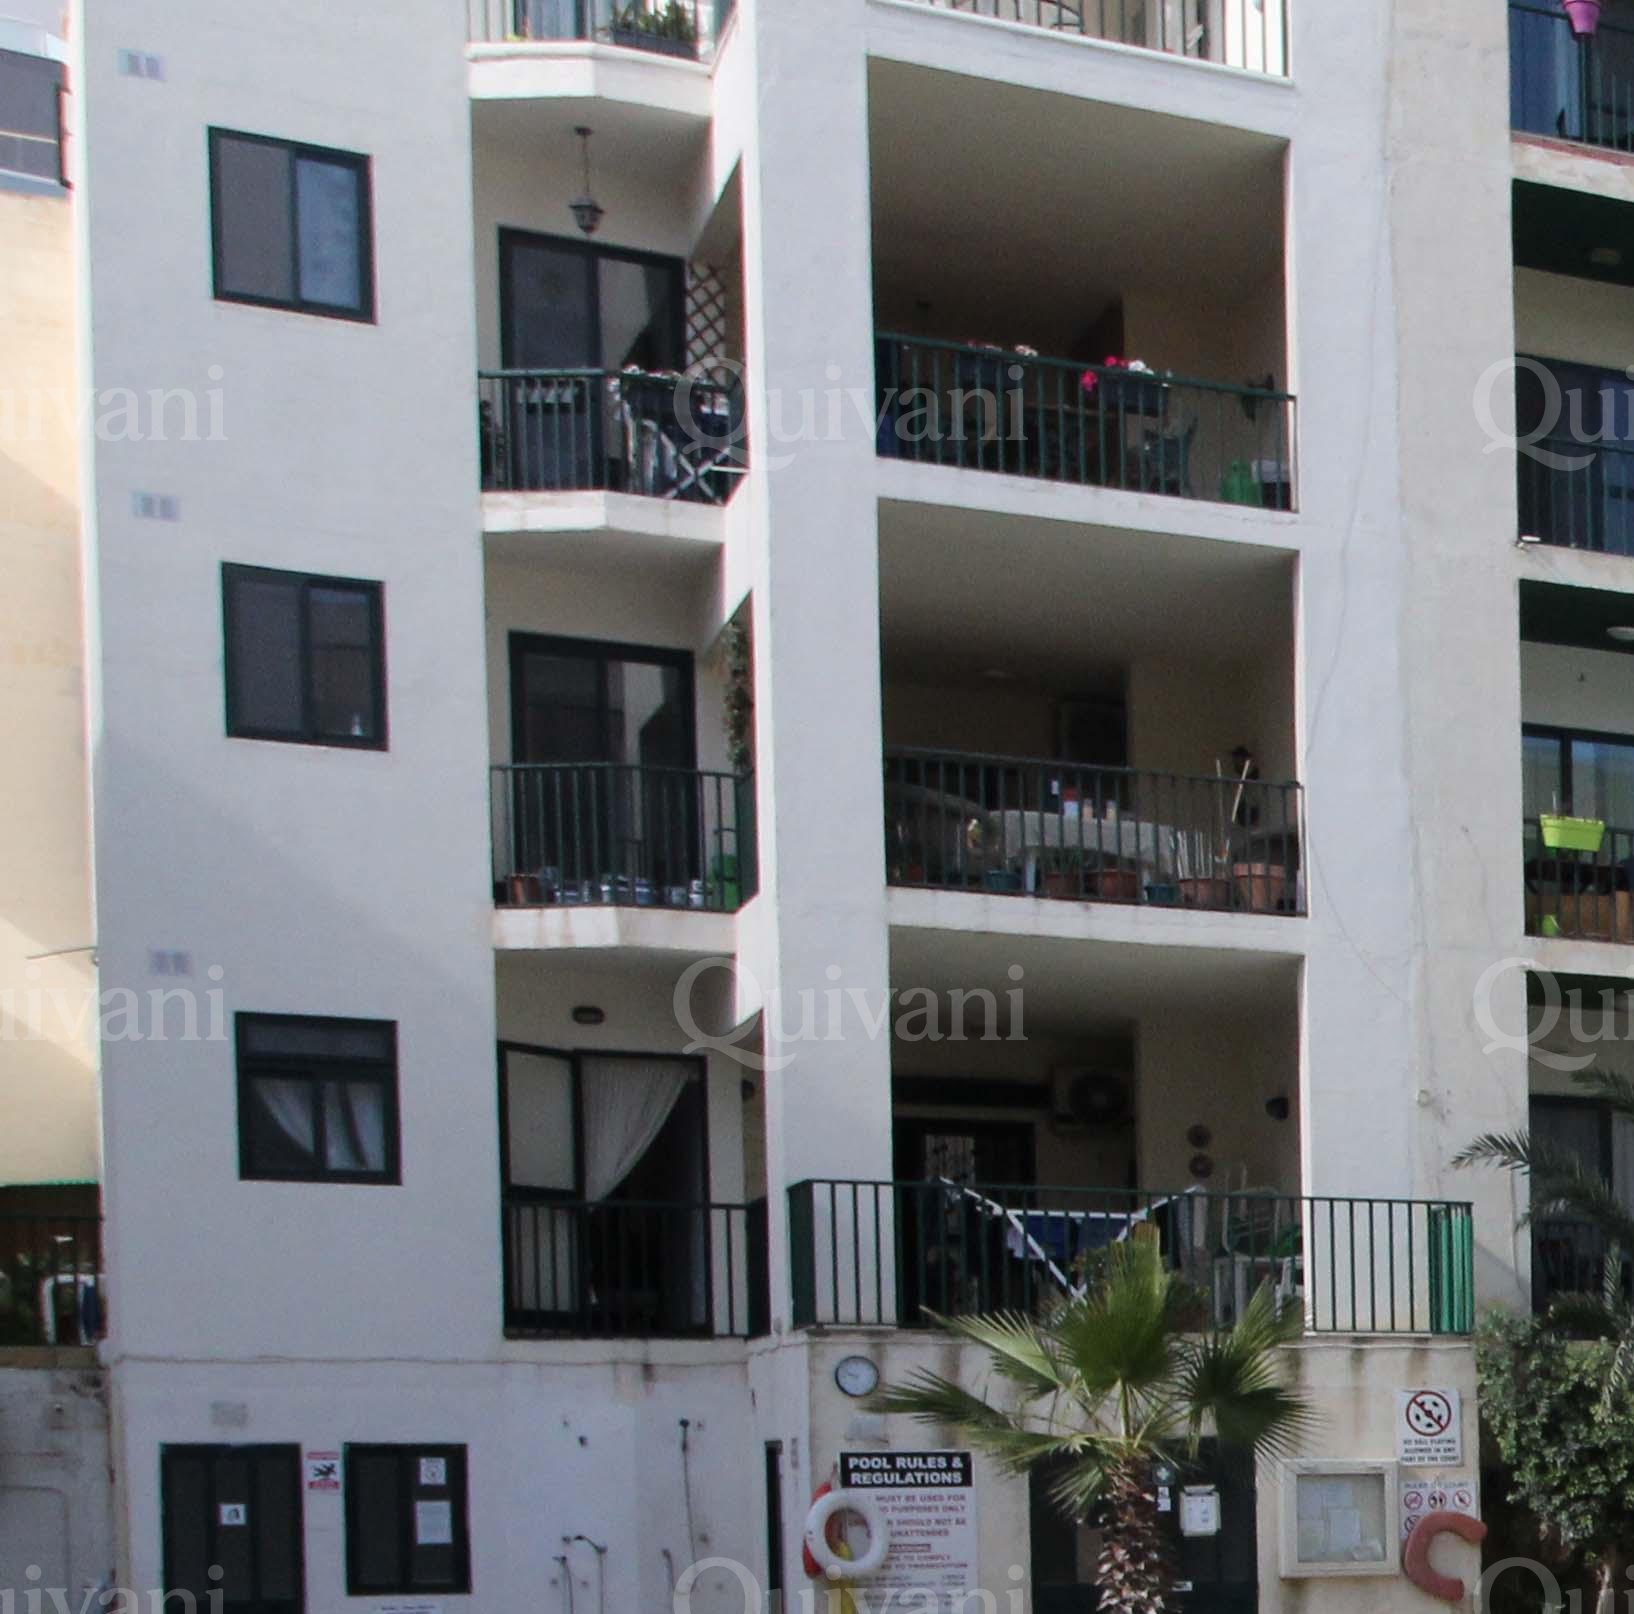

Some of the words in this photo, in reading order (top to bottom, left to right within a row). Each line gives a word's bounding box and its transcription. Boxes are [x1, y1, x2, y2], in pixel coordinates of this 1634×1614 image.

[848, 1457, 892, 1469] POOL
[896, 1457, 947, 1469] RULES
[952, 1457, 963, 1469] &
[851, 1472, 962, 1485] REGULATIONS
